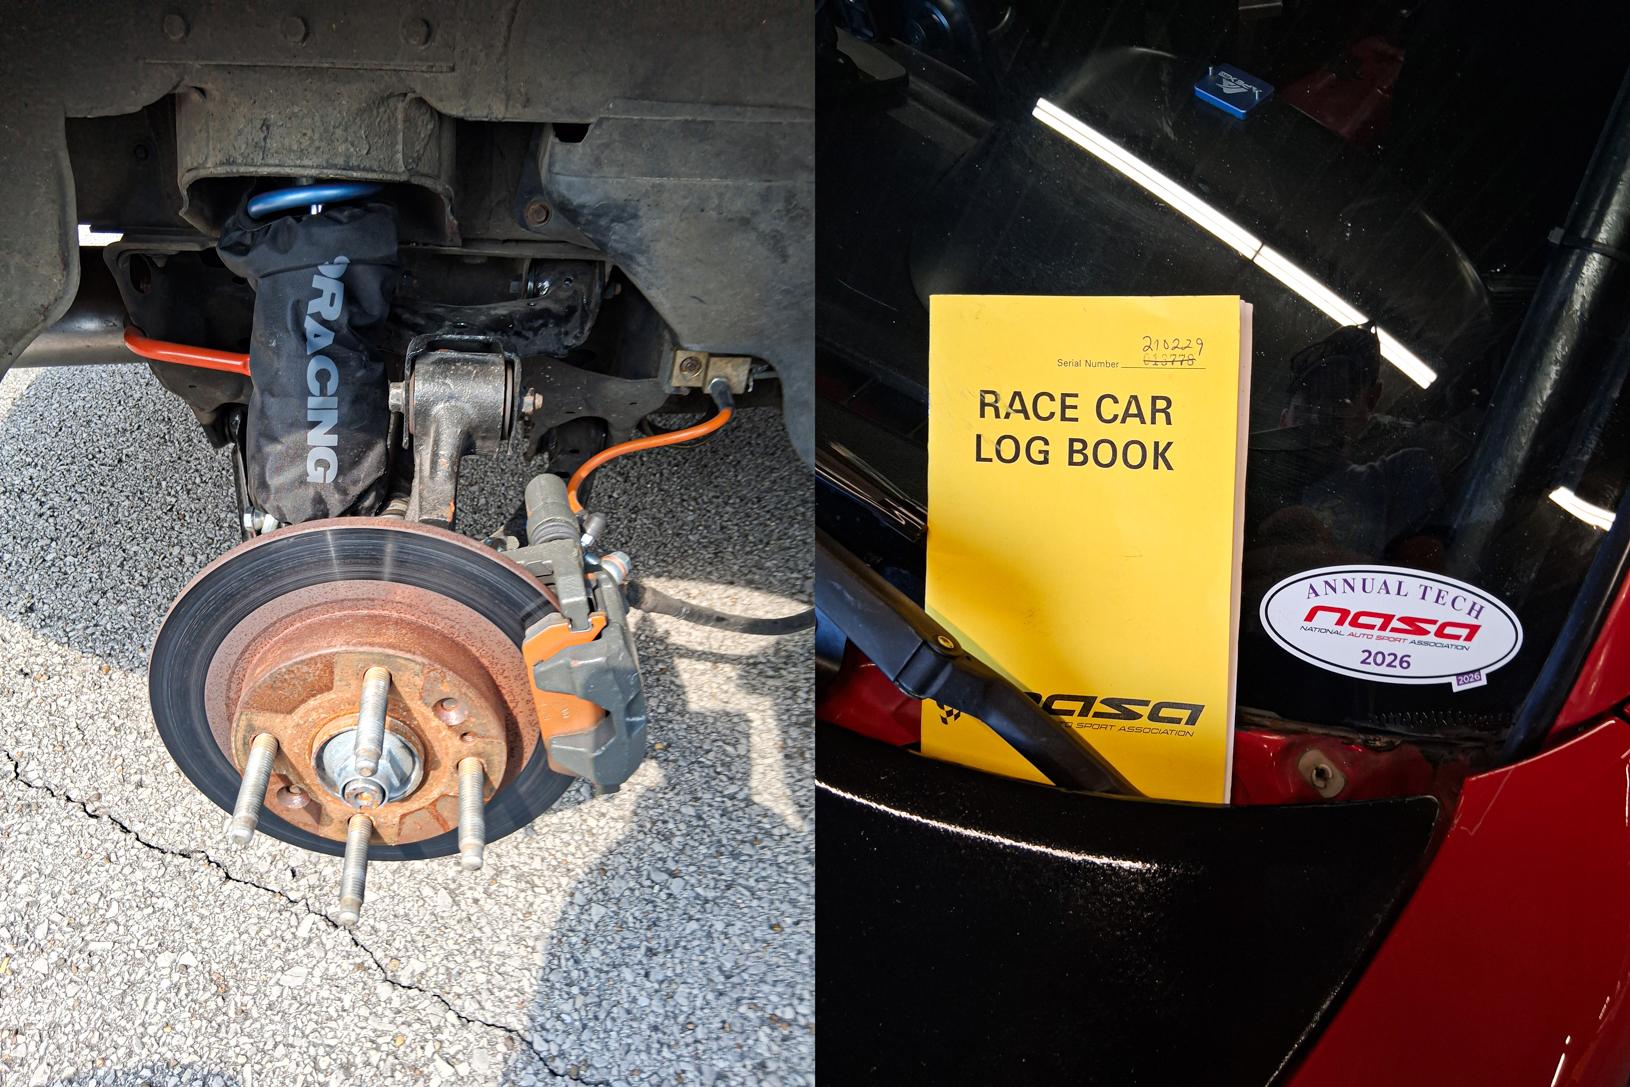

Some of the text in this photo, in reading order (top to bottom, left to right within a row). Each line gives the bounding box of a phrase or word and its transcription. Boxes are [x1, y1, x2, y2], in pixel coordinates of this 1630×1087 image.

[1142, 335, 1204, 356] 210229
[1057, 358, 1082, 368] Serial
[1085, 359, 1120, 368] Number
[979, 389, 1173, 426] RACE CAR
[975, 433, 1174, 471] LOG BOOK
[1306, 577, 1486, 621] ANNUAL TECH
[1299, 625, 1471, 651] NATIONAL AUTO SPORT ASSOCIATION
[1360, 649, 1412, 670] 2026
[1457, 672, 1481, 685] 2026
[1076, 722, 1116, 731] SPORT
[1118, 725, 1195, 738] ASSOCIATION
